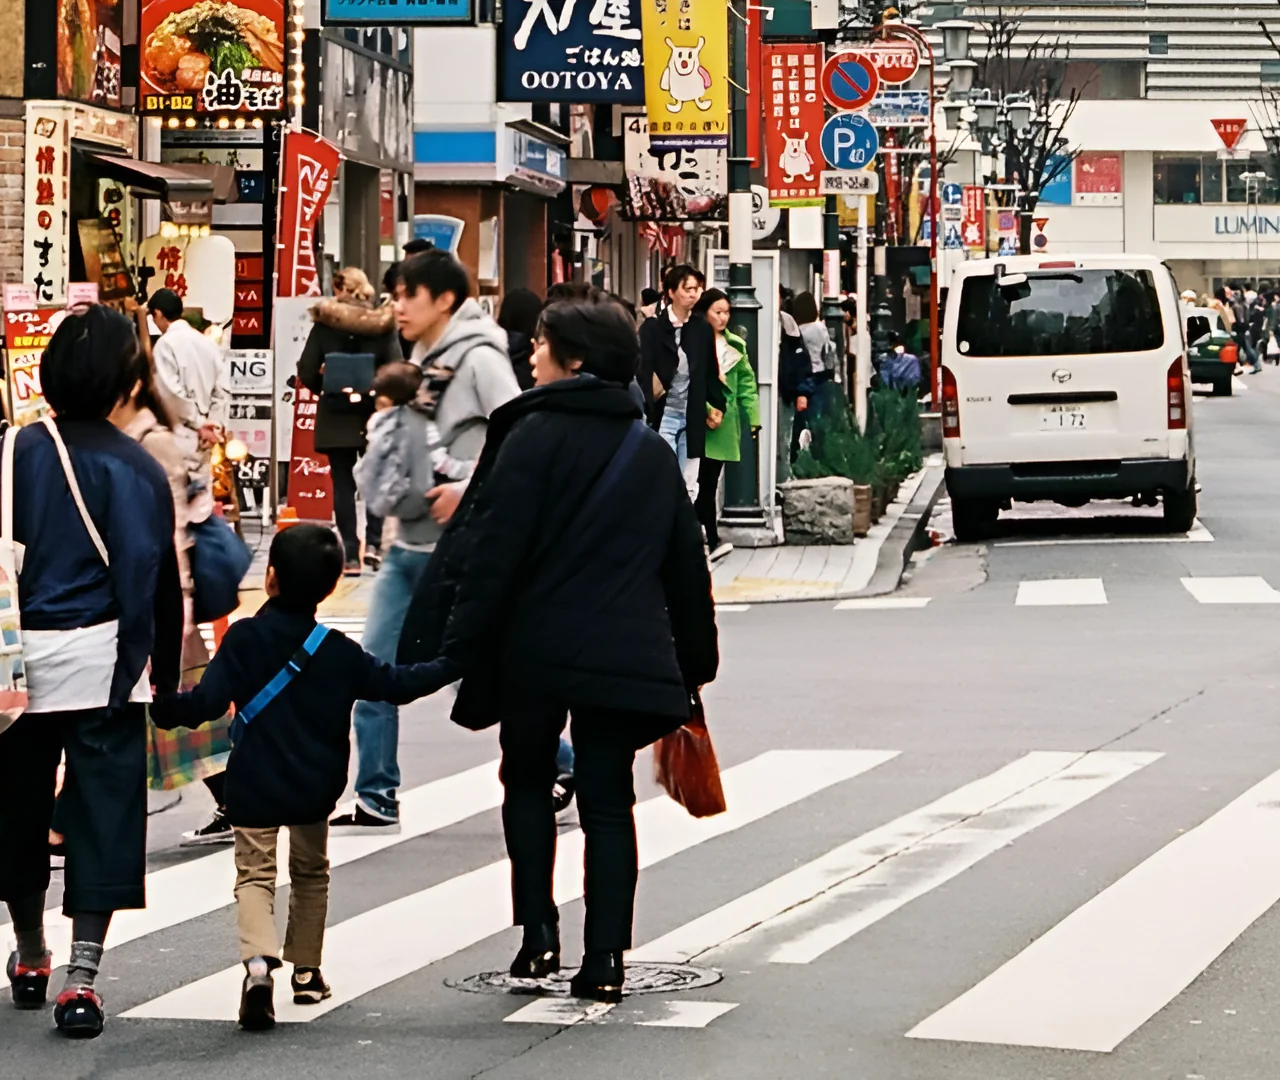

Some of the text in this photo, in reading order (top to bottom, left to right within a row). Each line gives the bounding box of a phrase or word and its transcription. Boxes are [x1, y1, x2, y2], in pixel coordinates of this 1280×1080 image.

[521, 70, 634, 91] OOTOYA
[833, 126, 856, 165] P
[230, 360, 267, 378] NG
